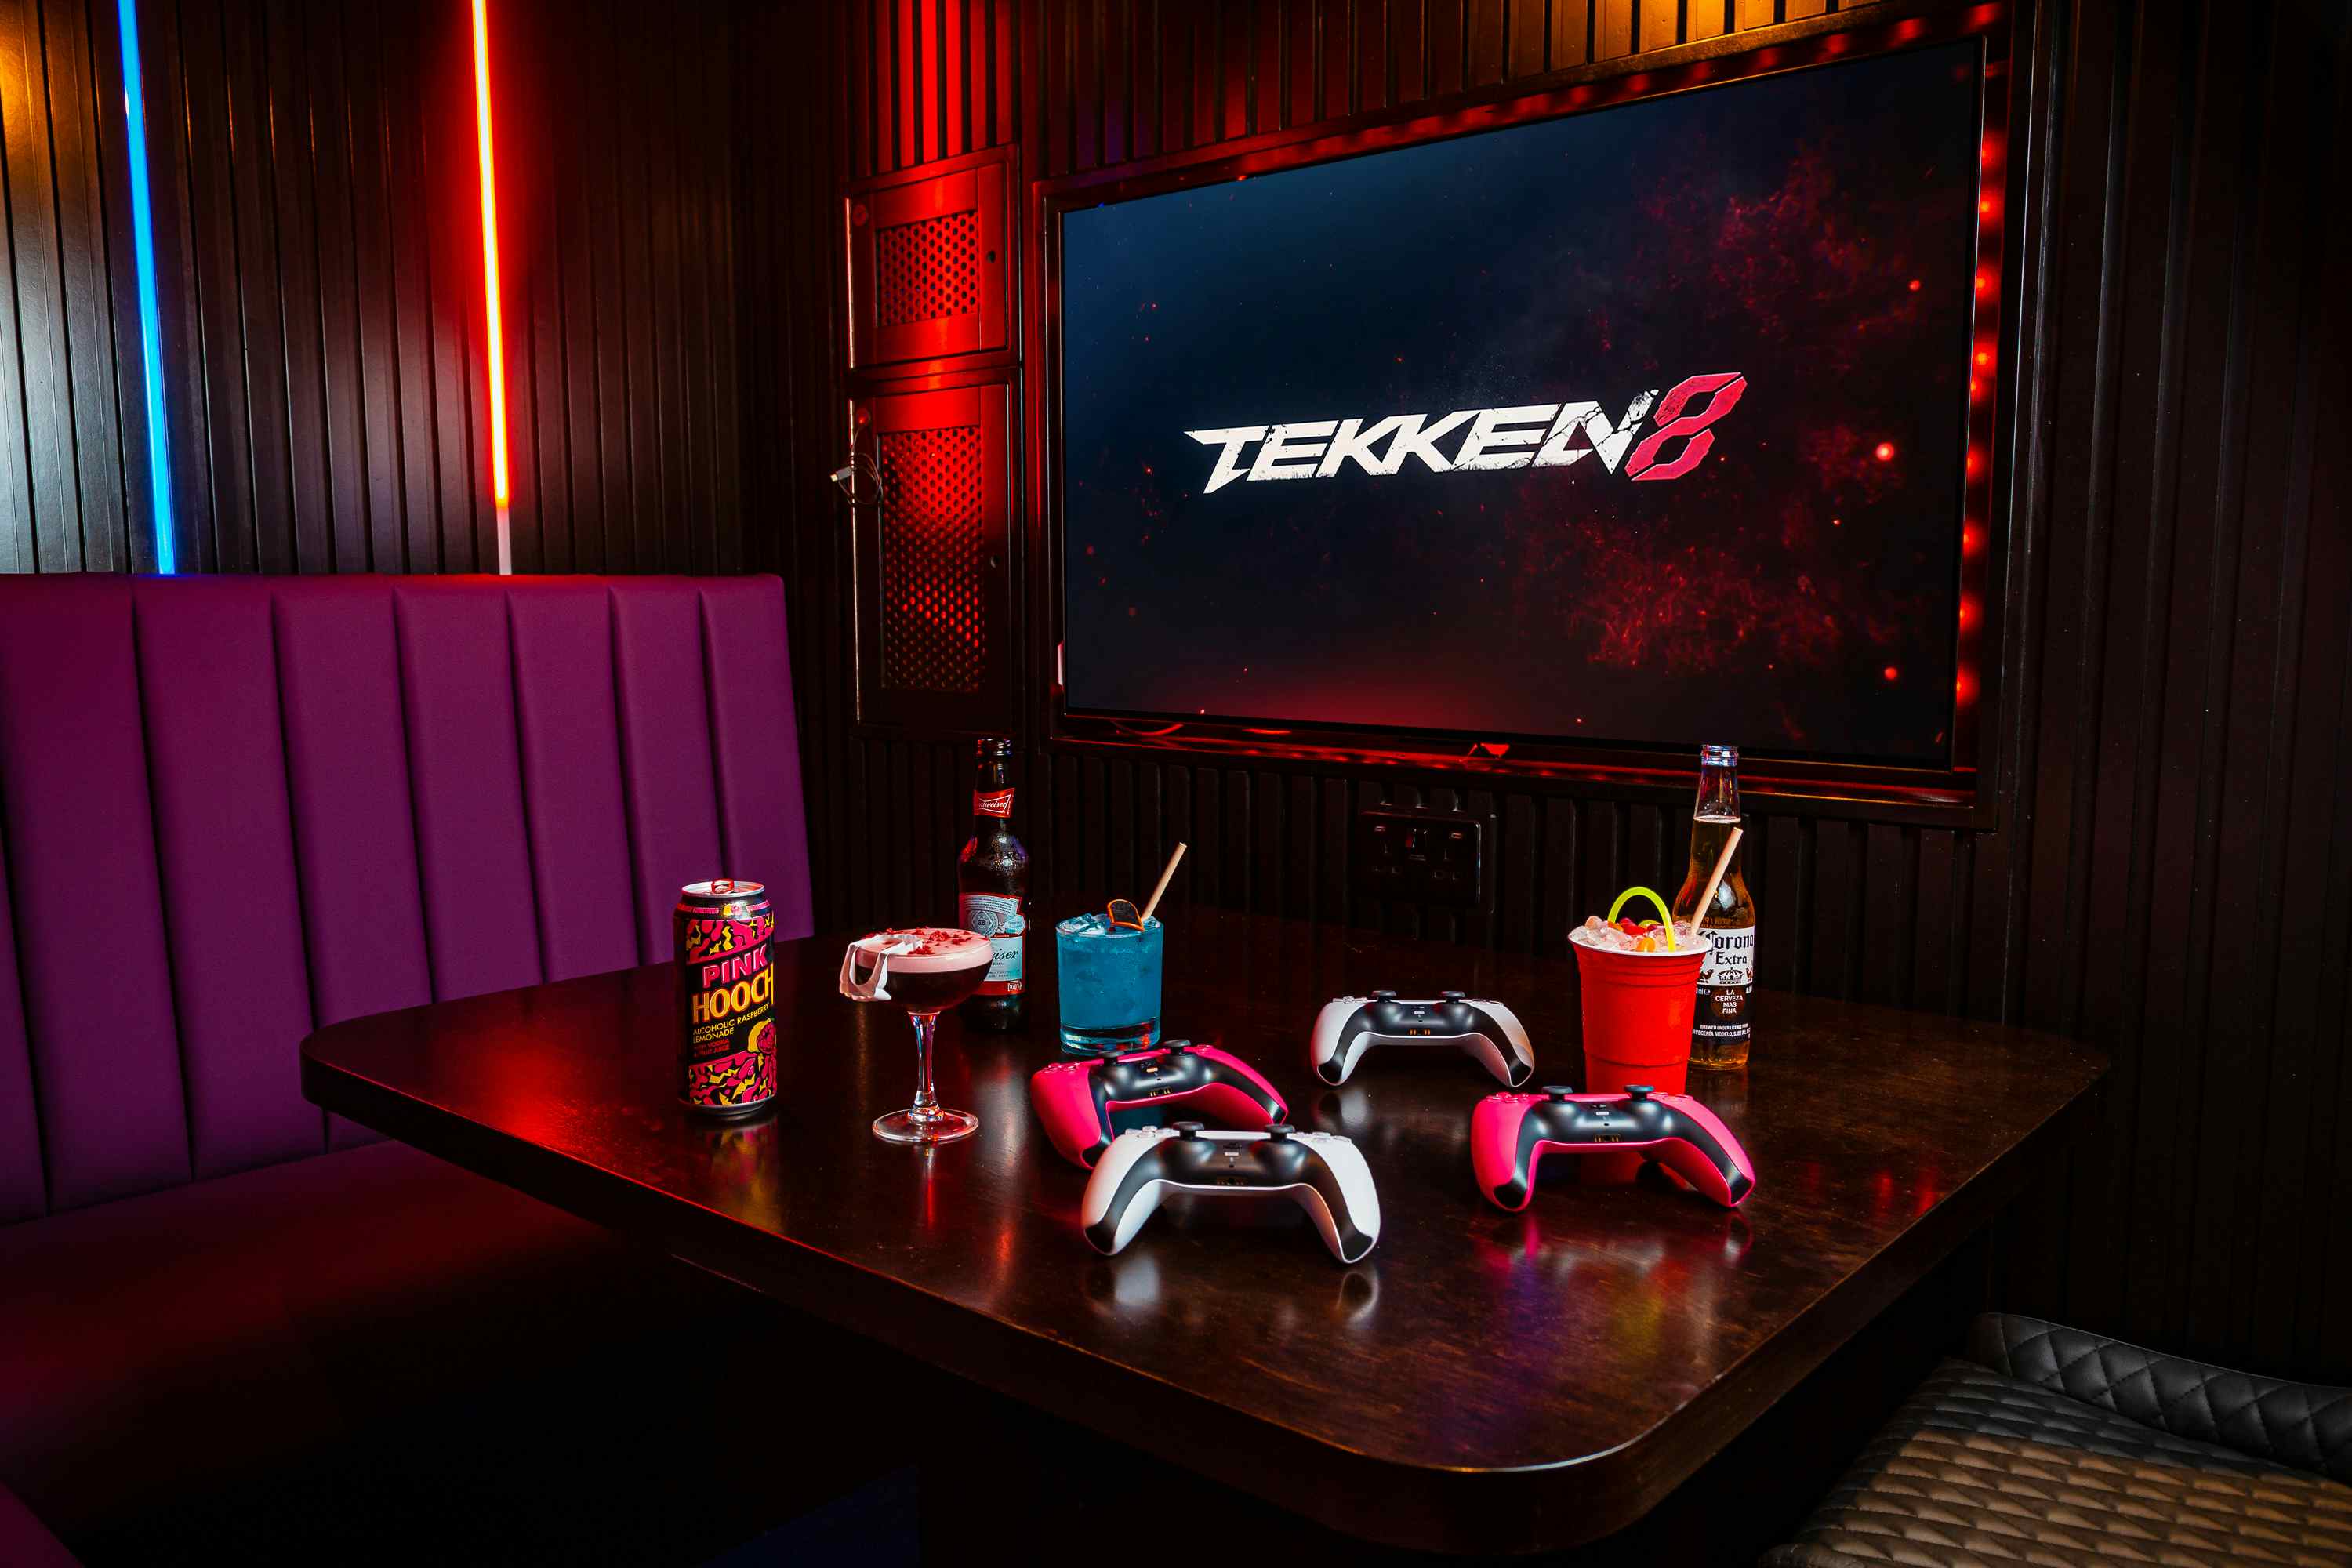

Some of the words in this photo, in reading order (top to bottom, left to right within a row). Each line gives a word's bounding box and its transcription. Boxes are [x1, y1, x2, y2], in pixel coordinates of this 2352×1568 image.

[1183, 389, 1659, 494] TEKKEN
[1624, 372, 1748, 481] 8
[703, 943, 768, 989] PINK
[991, 948, 1019, 960] eiser
[1715, 951, 1747, 965] Extra
[692, 961, 775, 1025] HOOCH
[693, 1019, 735, 1036] ALCOHOLIC
[737, 1002, 770, 1025] RASPBERRY
[693, 1027, 735, 1044] LEMONADE
